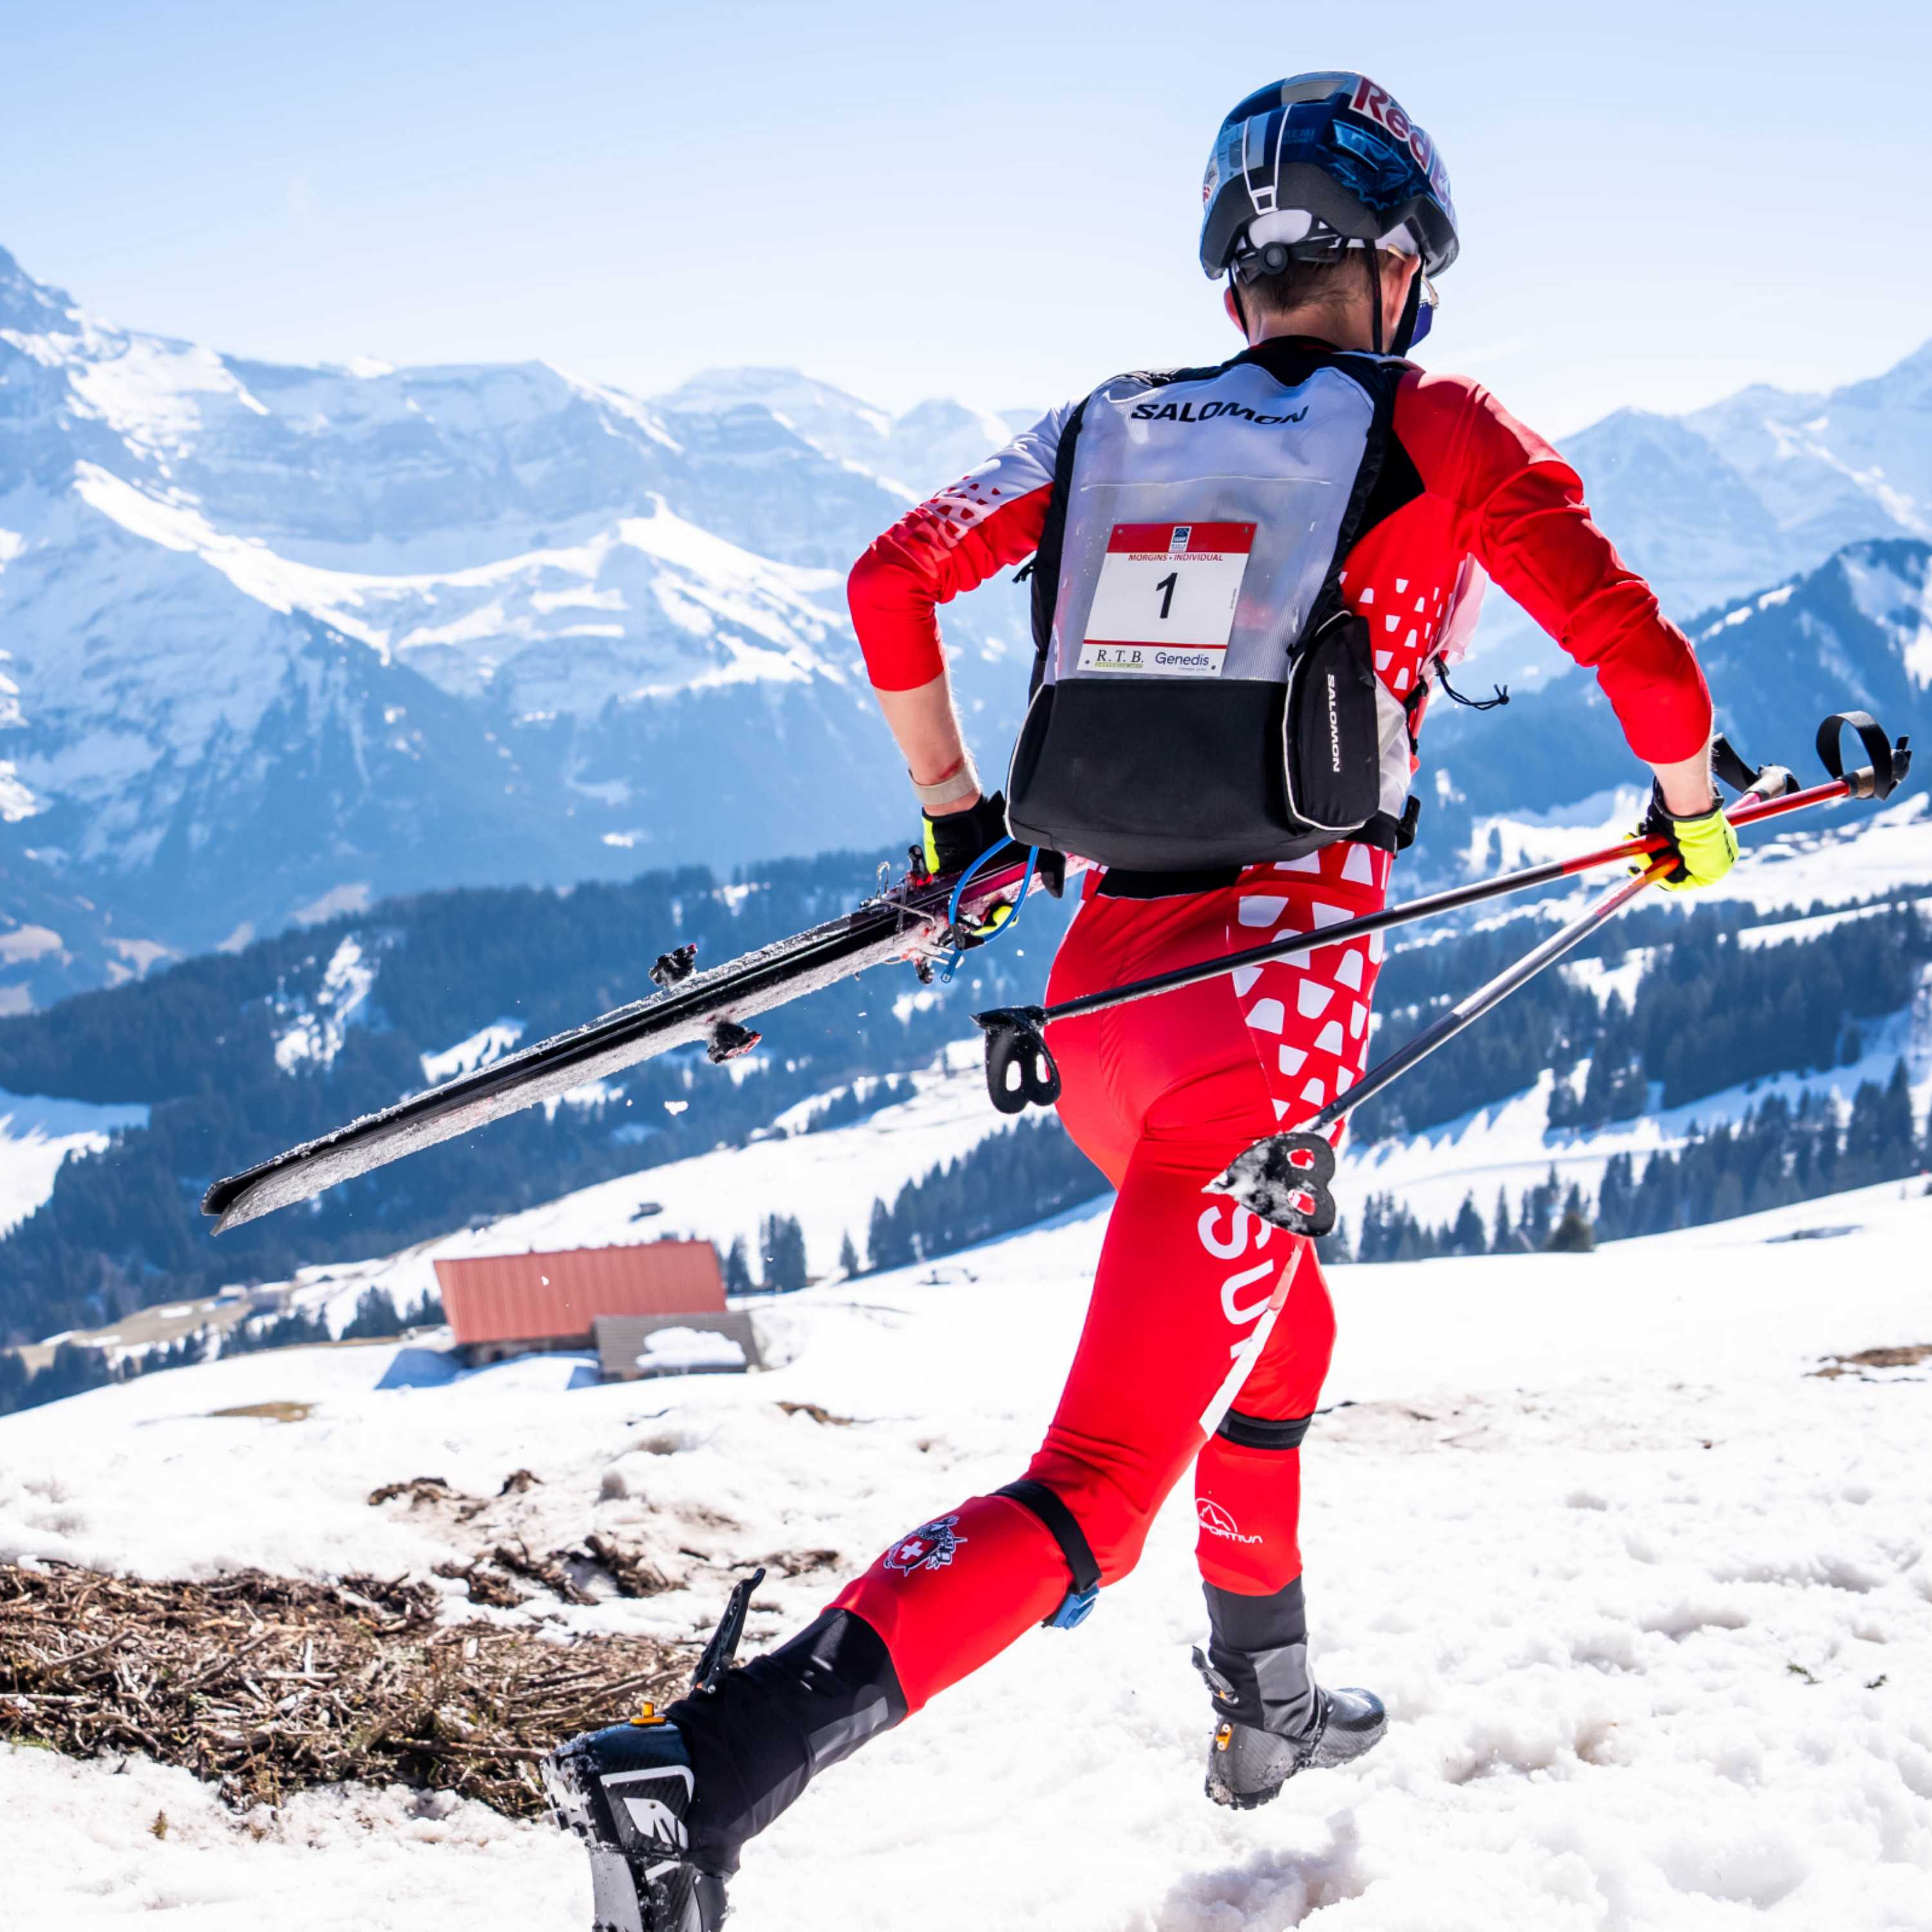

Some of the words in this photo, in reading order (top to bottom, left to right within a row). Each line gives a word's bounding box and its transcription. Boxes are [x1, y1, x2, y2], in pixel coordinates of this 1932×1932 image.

[1353, 76, 1432, 171] Red
[1131, 401, 1309, 424] SALOMON
[1156, 572, 1178, 619] 1
[1155, 652, 1209, 666] Genedis
[1327, 674, 1340, 773] SALOMON
